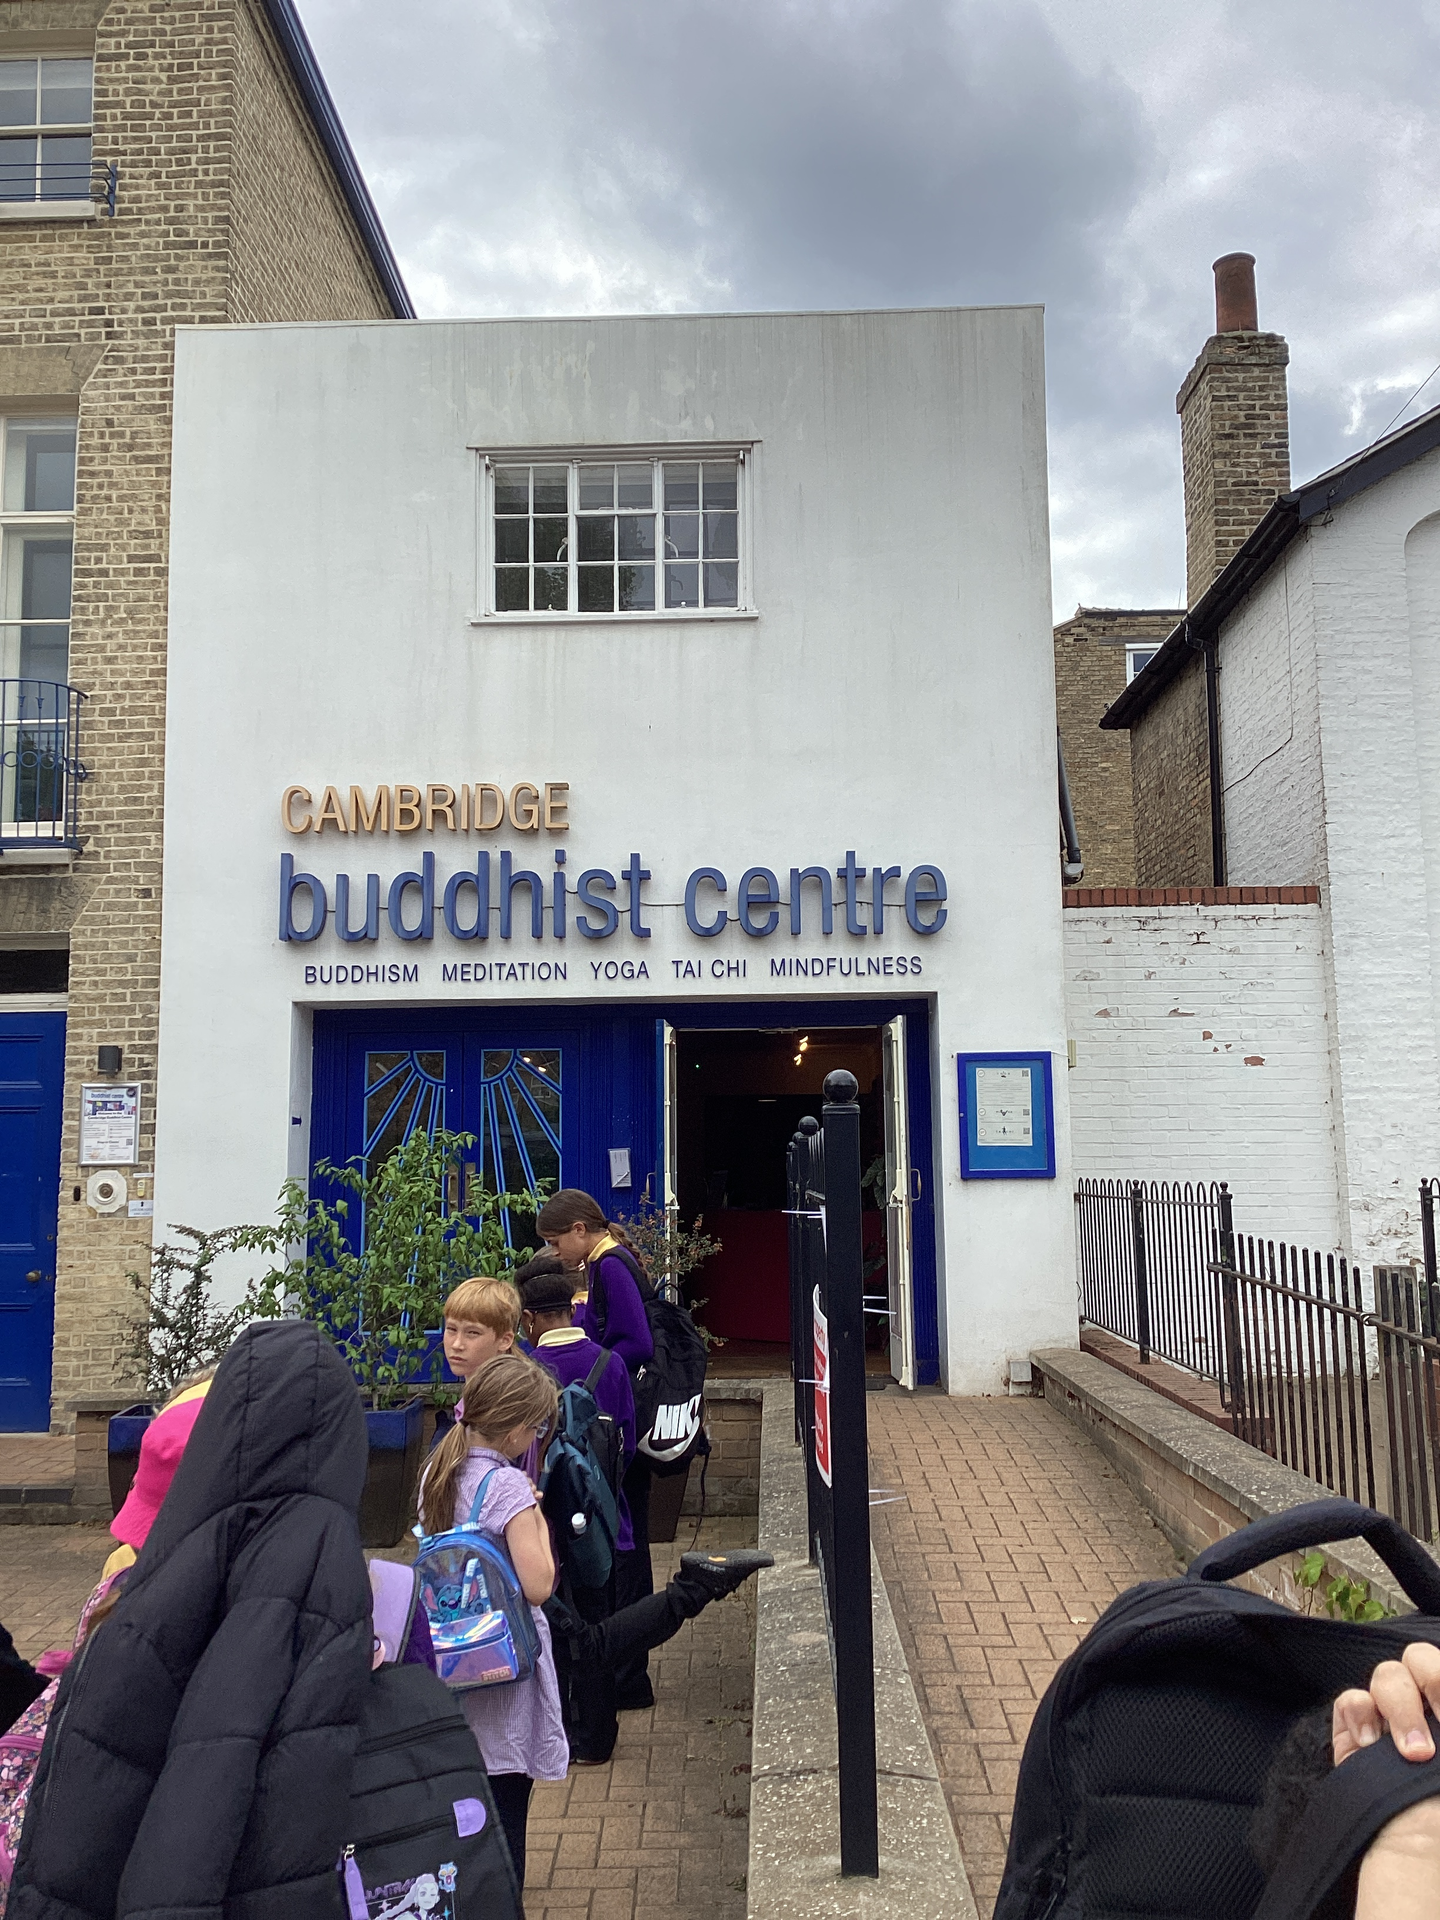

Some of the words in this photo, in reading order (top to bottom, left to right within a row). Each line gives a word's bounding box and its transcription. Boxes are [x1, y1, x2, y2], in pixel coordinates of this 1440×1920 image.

[281, 782, 570, 834] CAMBRIDGE
[278, 849, 652, 942] buddhist
[684, 850, 948, 938] centre
[304, 964, 420, 986] BUDDHISM
[442, 961, 568, 983] MEDITATION
[590, 960, 651, 980] YOGA
[672, 959, 706, 979] TAI
[711, 959, 747, 978] CHI
[770, 956, 923, 977] MINDFULNESS
